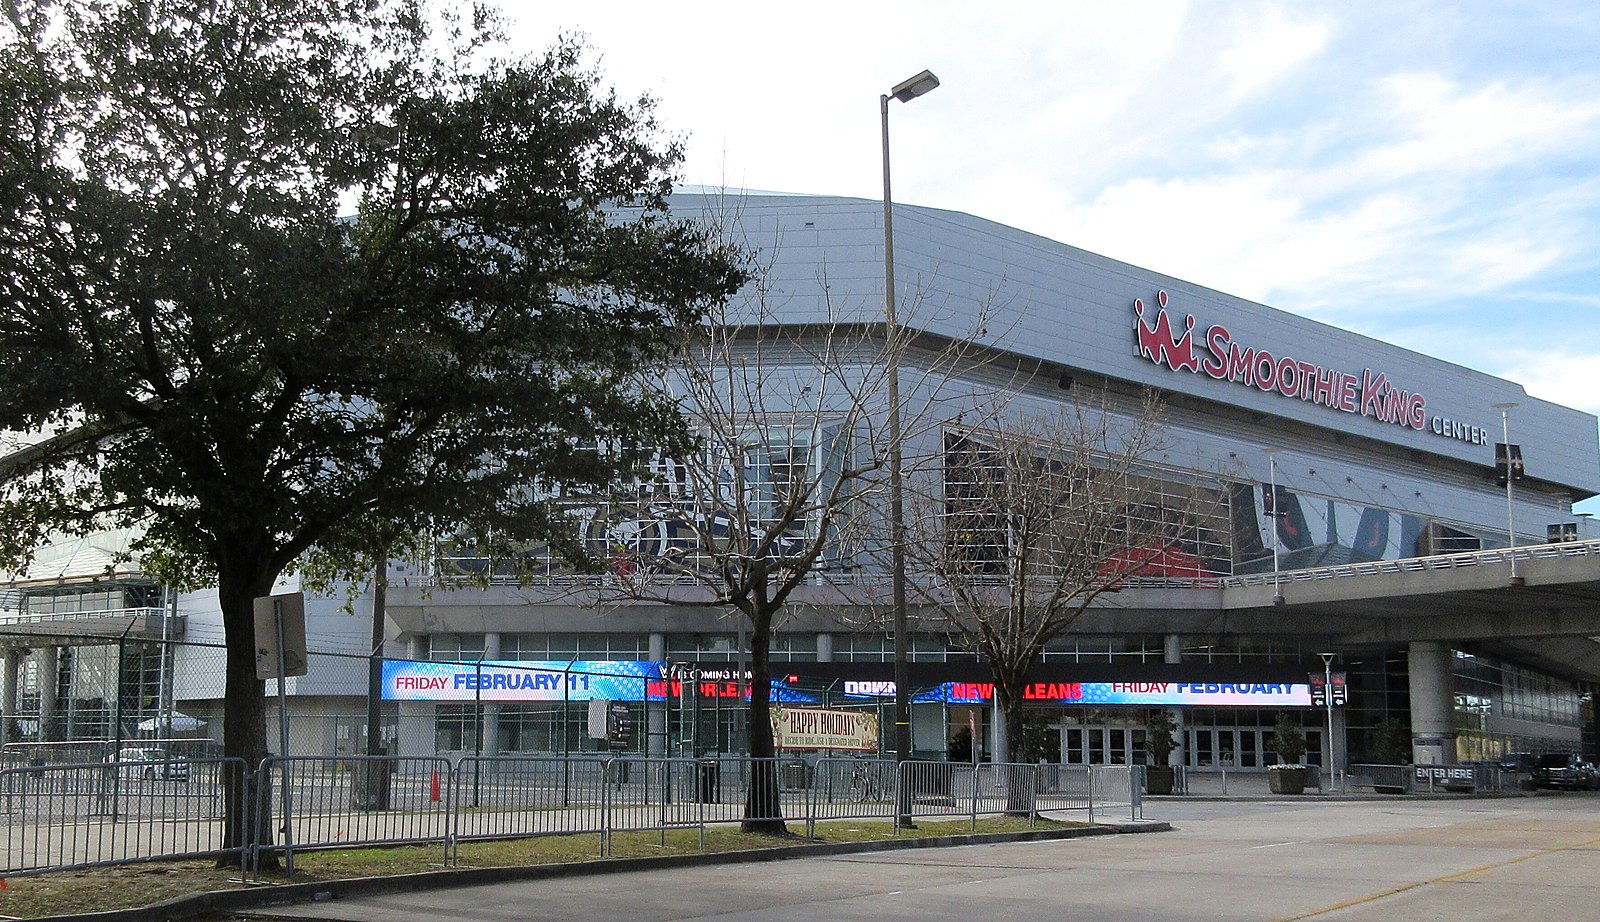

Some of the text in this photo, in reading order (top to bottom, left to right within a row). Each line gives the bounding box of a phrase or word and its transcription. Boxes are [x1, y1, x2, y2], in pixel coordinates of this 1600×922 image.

[1202, 325, 1358, 413] SMOOTHIE
[1432, 416, 1488, 446] CENTER
[396, 673, 590, 690] FRIDAY FEBRUARY 11
[1113, 682, 1169, 693] FRIDAY
[1177, 682, 1294, 694] FEBRUARY
[952, 682, 1083, 699] NEW LEANS
[790, 711, 856, 736] HAPPY HOLIDAYS
[1416, 768, 1473, 778] ENTER HERE
